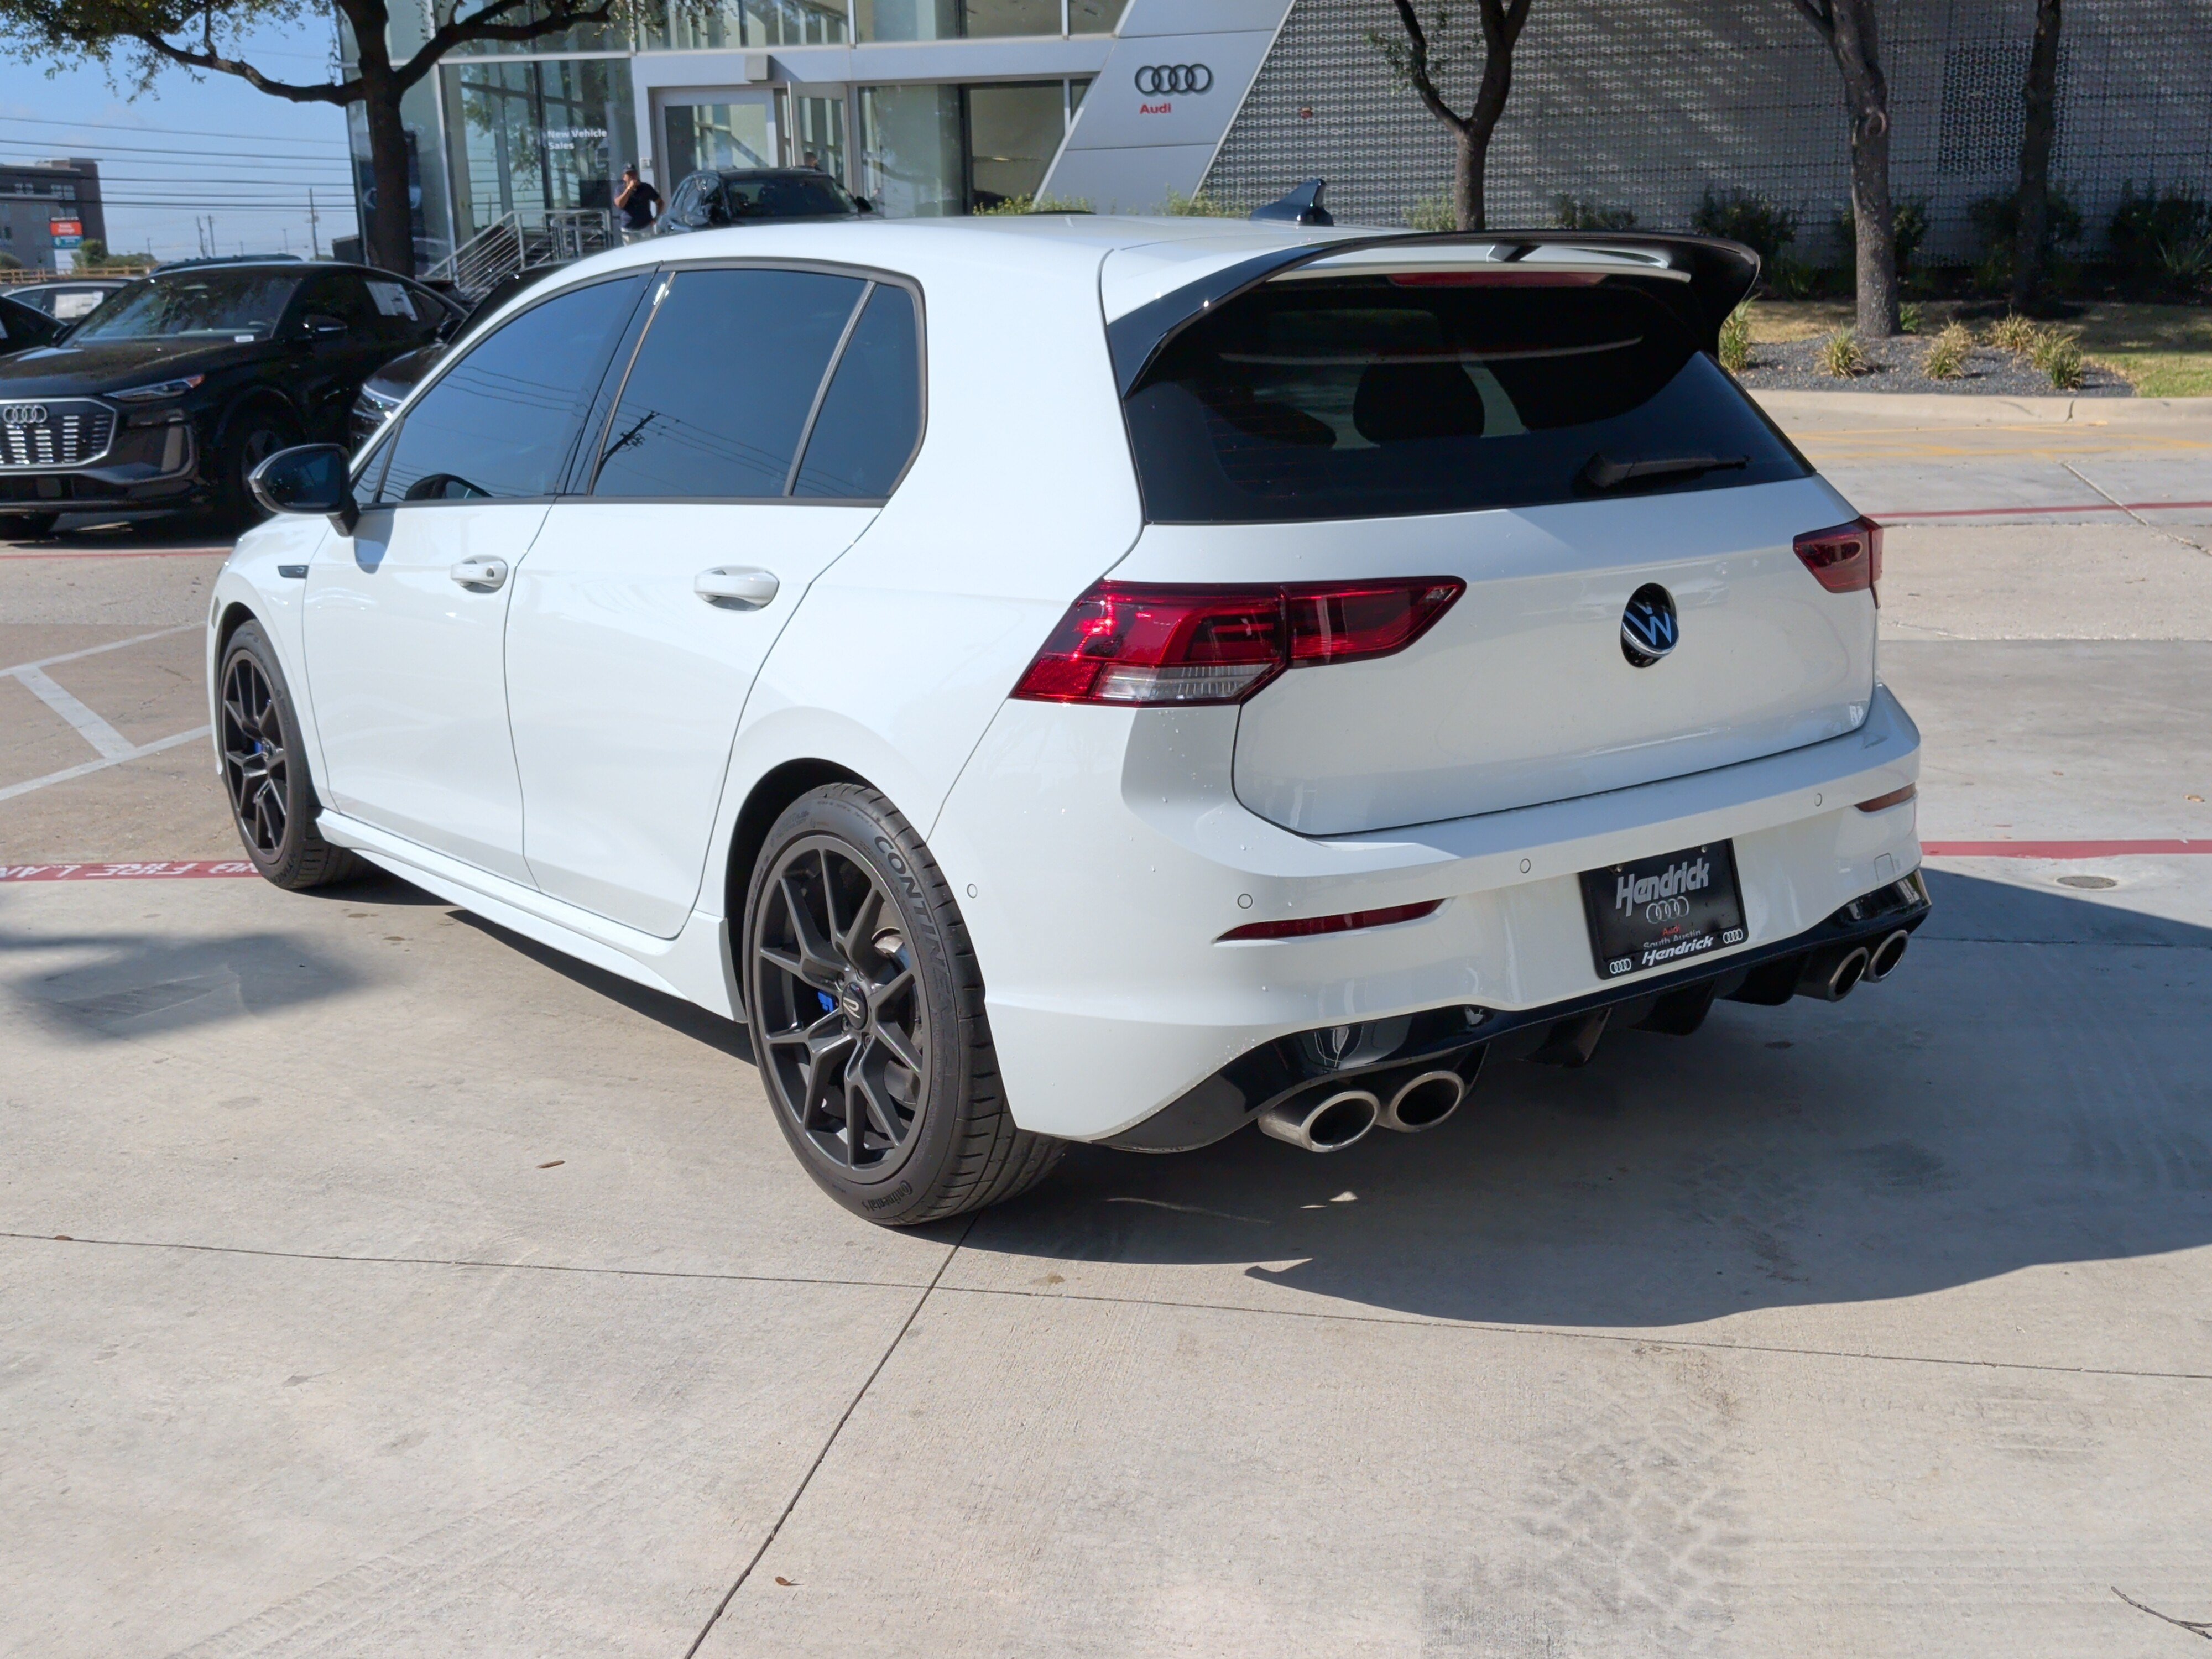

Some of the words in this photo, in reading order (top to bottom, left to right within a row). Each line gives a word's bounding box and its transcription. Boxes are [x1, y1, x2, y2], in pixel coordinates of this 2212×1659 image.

[1139, 103, 1171, 114] Audi
[547, 130, 570, 138] New
[571, 128, 607, 138] Vehicle
[548, 142, 575, 150] Sales
[0, 864, 82, 879] LAN
[85, 862, 198, 877] FIRE
[1615, 858, 1710, 917] Hendrick
[1673, 929, 1702, 942] Austin
[1641, 935, 1714, 967] Hendrick
[868, 1180, 913, 1211] Continental
